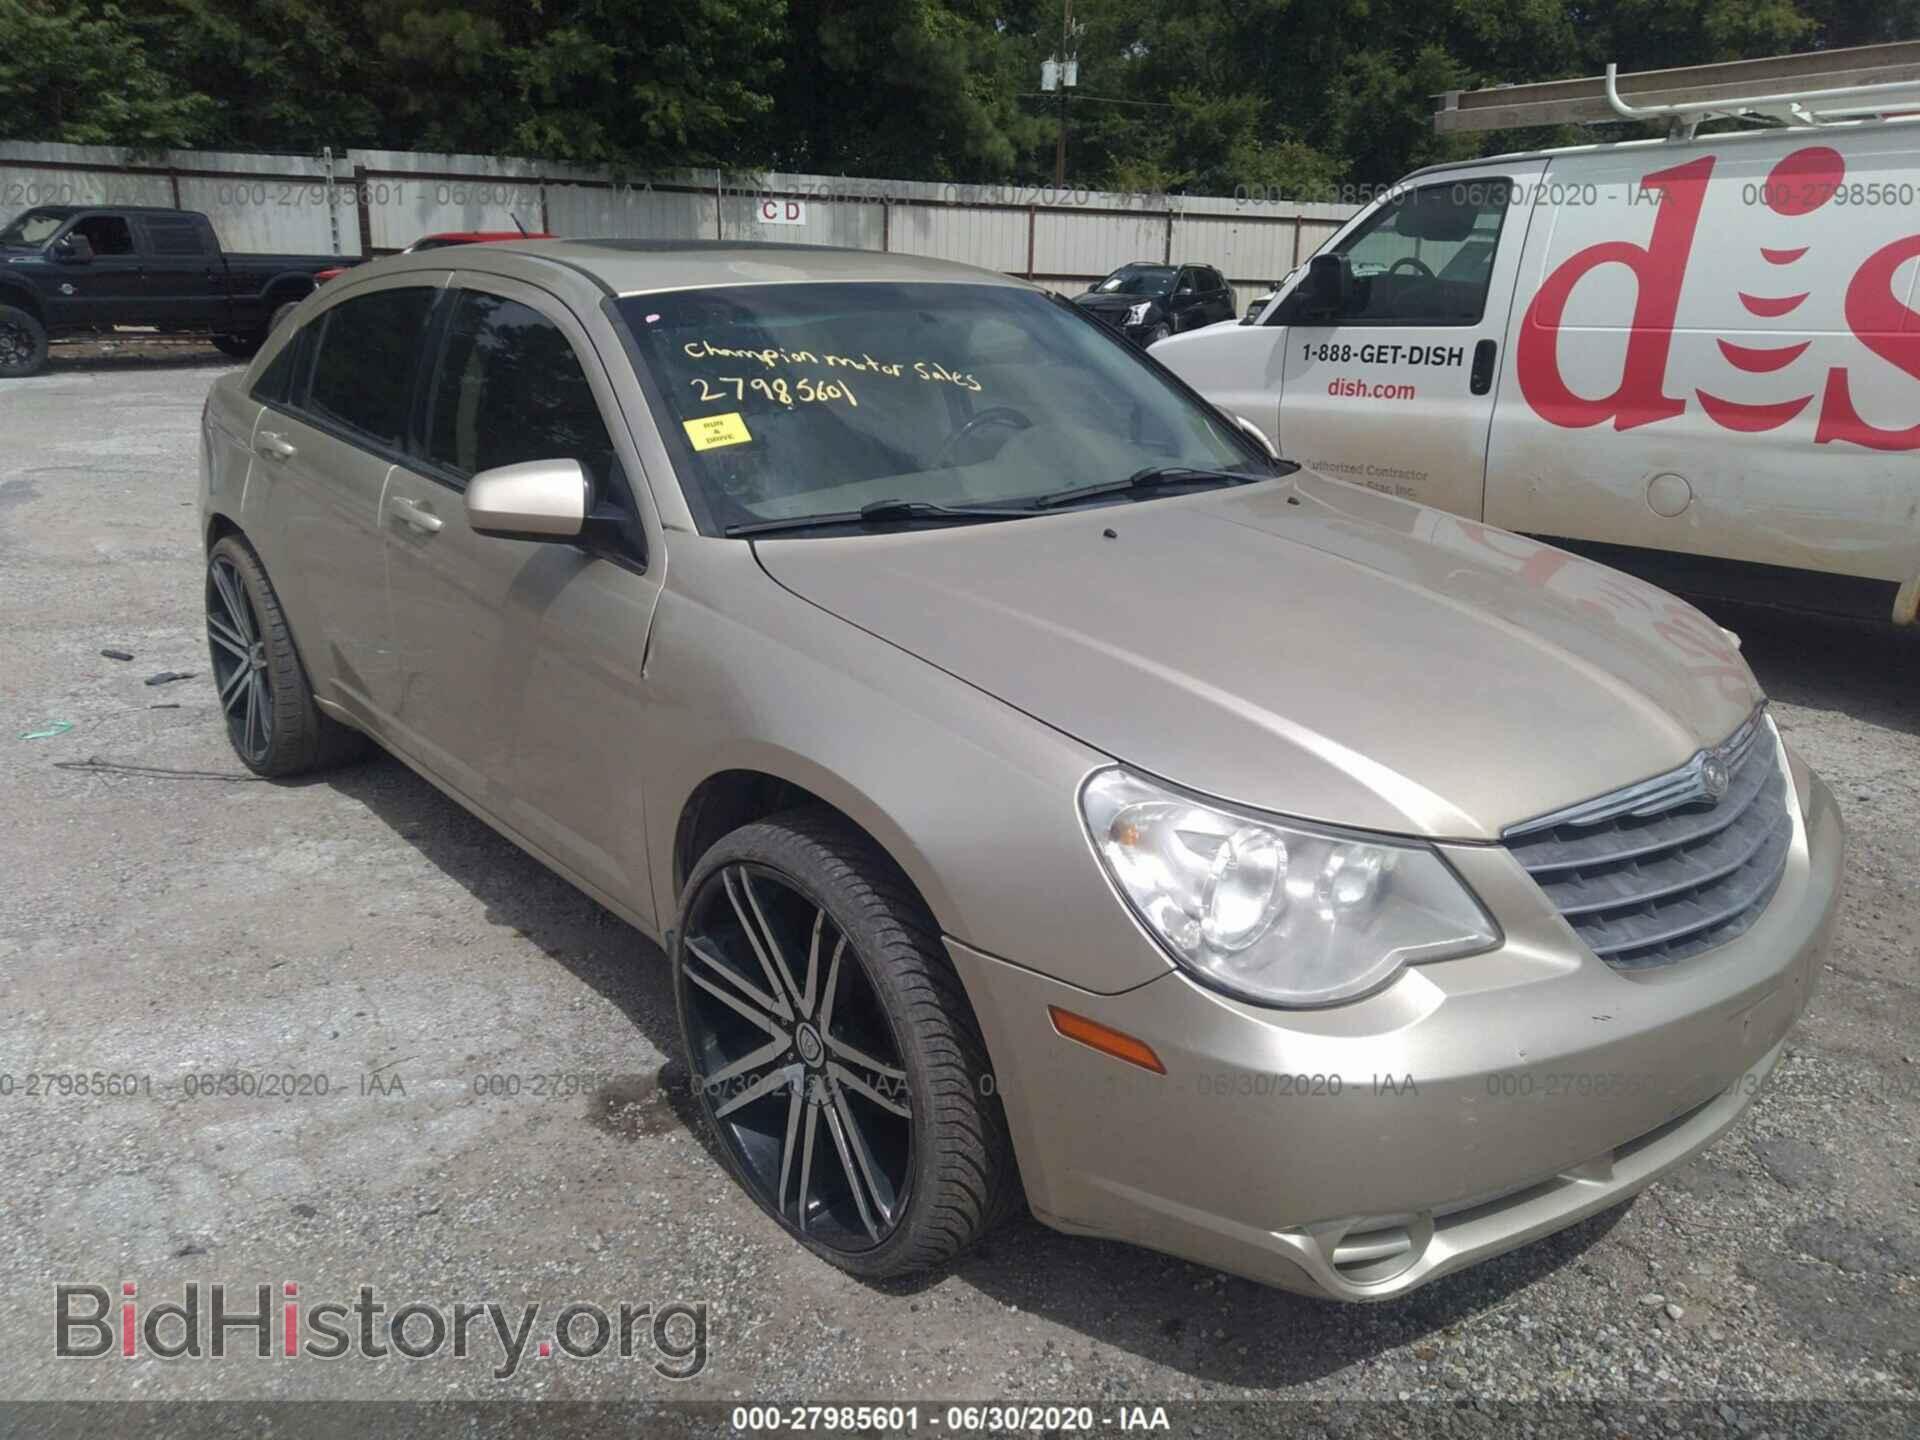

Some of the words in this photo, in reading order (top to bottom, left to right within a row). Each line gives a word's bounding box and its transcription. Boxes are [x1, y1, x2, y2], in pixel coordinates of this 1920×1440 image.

[1304, 344, 1463, 366] 1-888-GET-DISH
[690, 377, 858, 407] 27985601
[1328, 378, 1416, 399] dish.com
[703, 420, 724, 429] RUN
[1306, 458, 1363, 475] uthorized
[1366, 464, 1429, 481] Contractor
